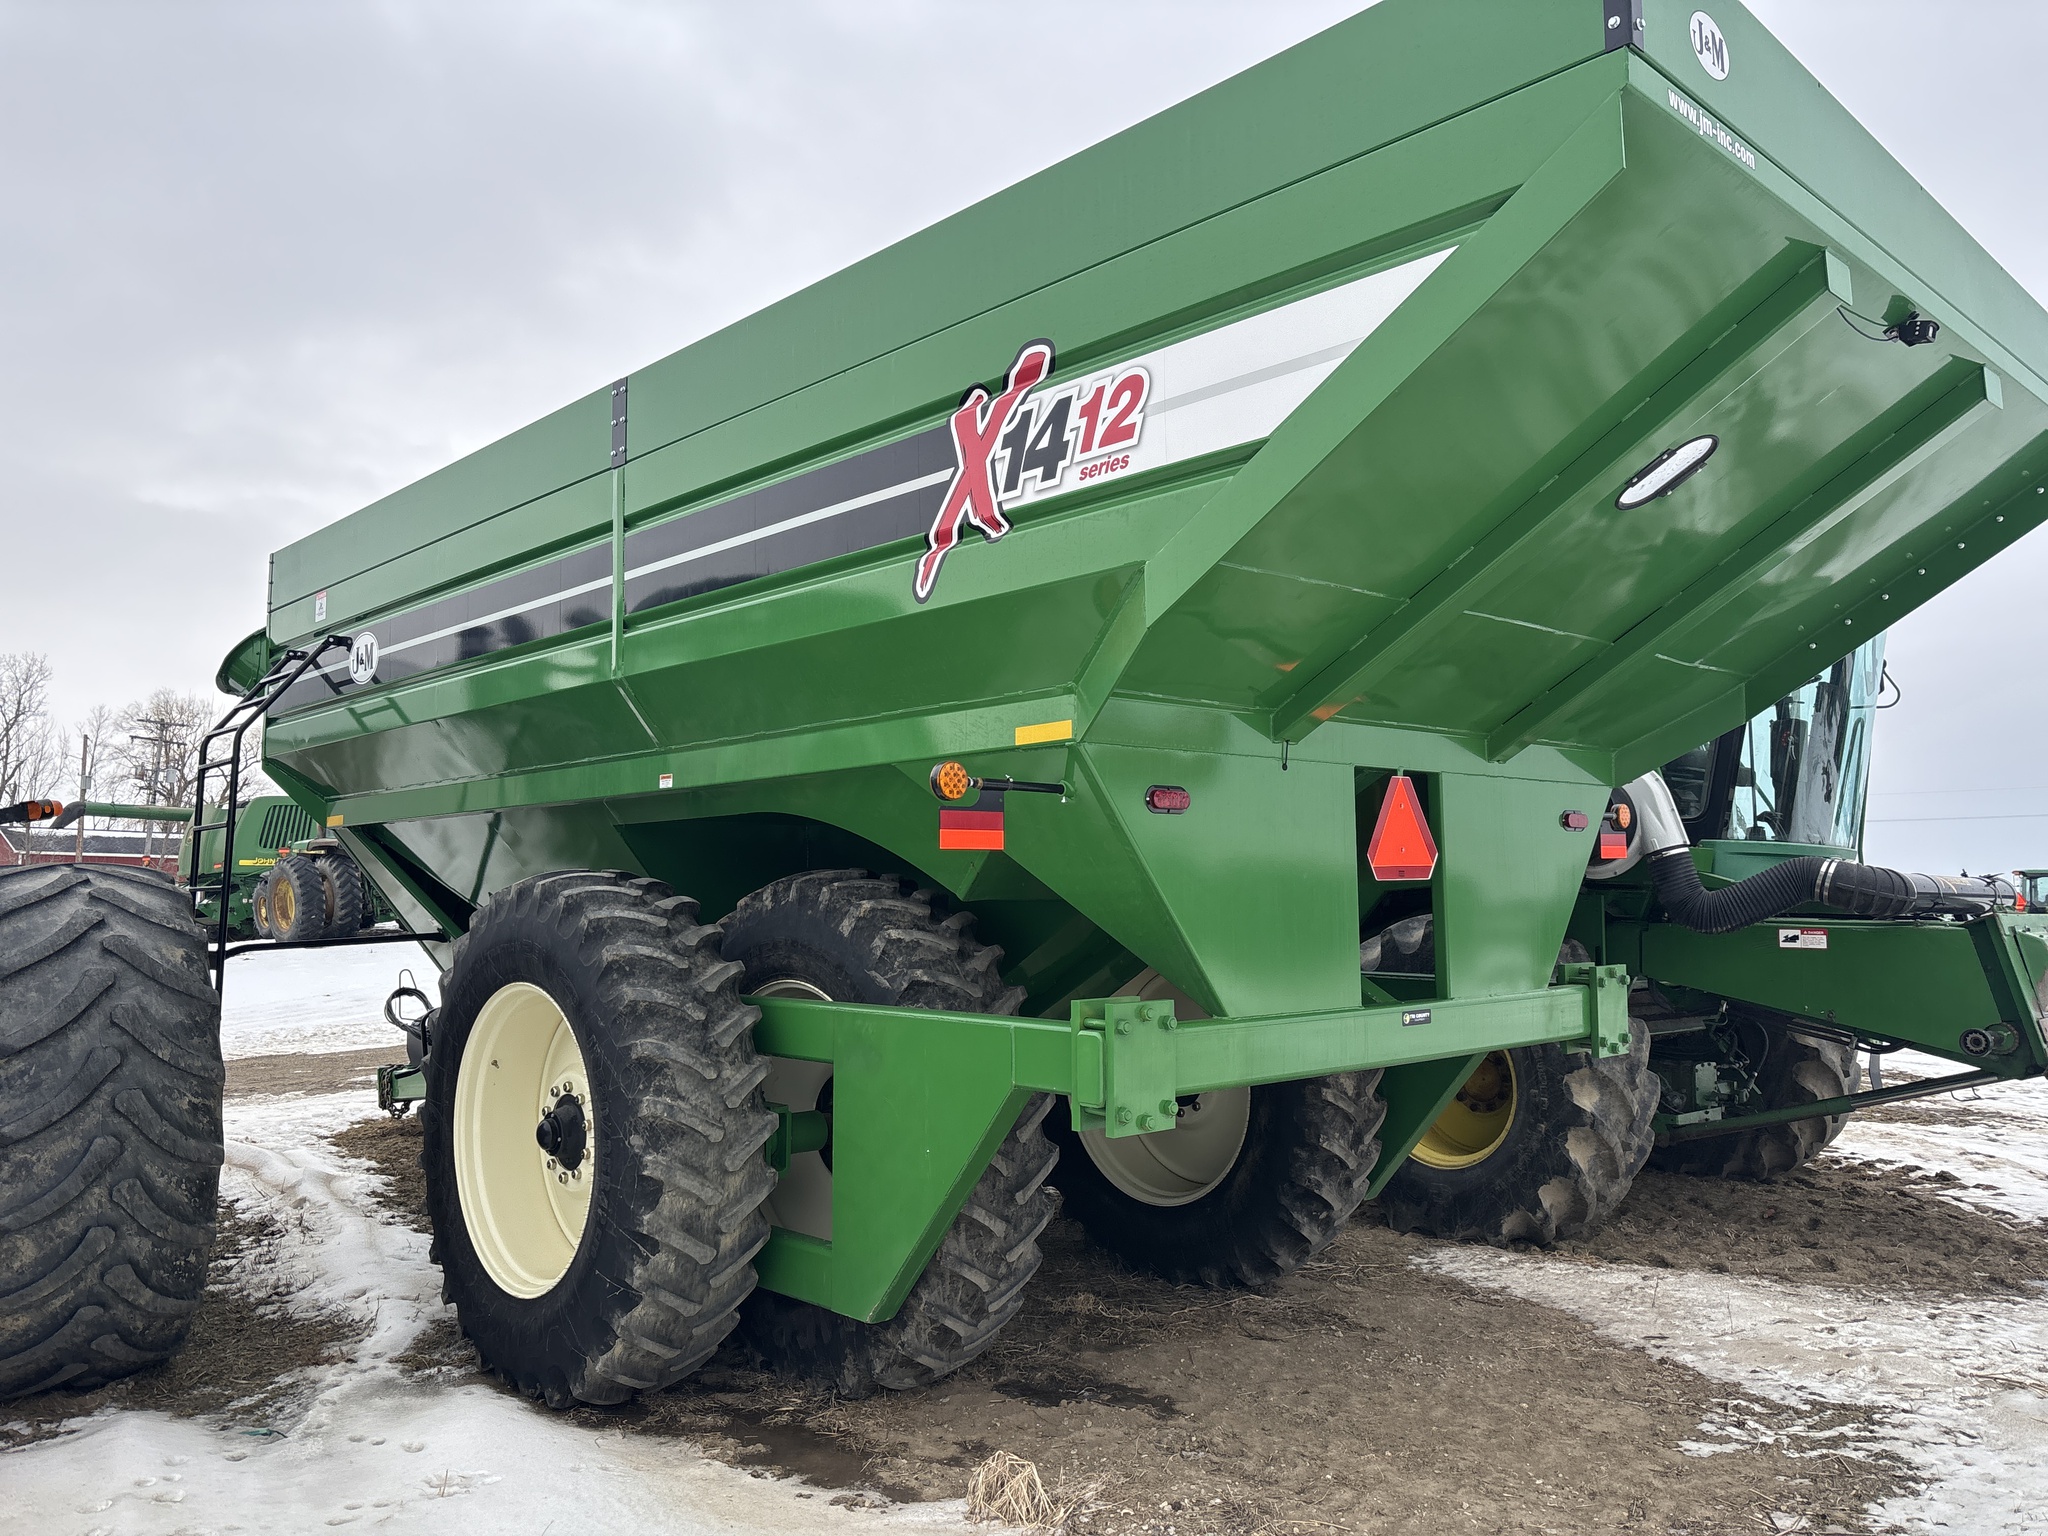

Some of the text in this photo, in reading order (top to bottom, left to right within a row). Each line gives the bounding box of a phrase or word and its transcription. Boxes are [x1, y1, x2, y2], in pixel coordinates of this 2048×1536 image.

[1691, 18, 1726, 75] J&M
[1667, 87, 1756, 170] www.jm-inc.com
[1079, 454, 1130, 482] series
[351, 642, 375, 675] J&M
[252, 856, 276, 865] JOHN
